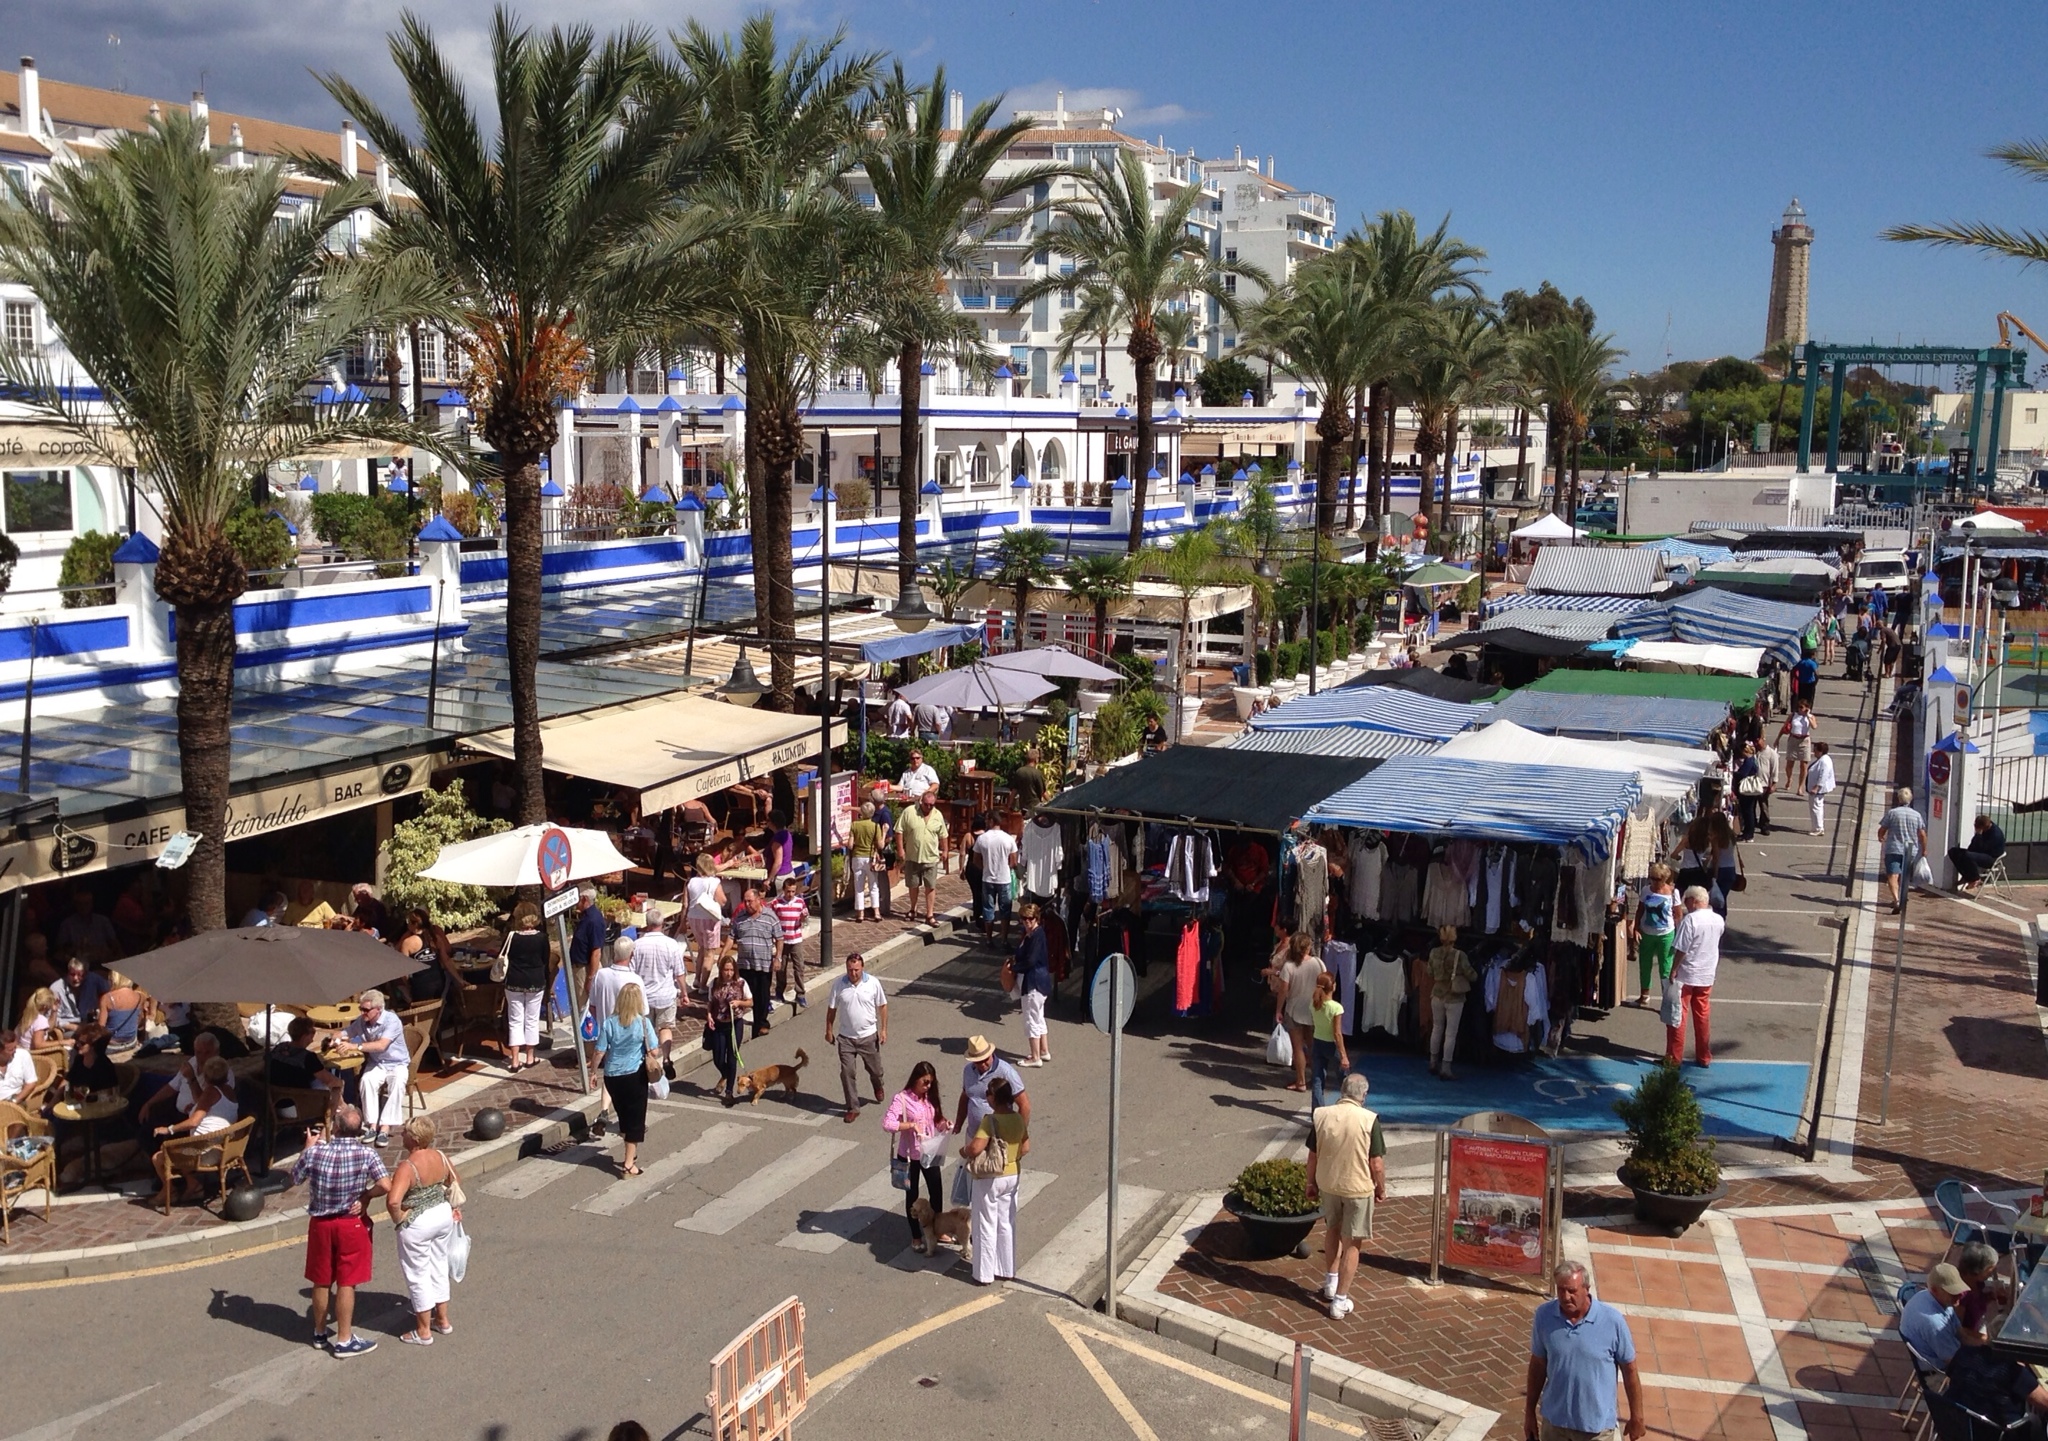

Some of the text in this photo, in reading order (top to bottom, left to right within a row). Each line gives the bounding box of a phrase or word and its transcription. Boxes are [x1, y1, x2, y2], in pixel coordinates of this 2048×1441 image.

[1878, 353, 1930, 361] PESCADORES
[1933, 353, 1975, 361] ESTEPONA
[39, 441, 93, 458] copas
[1115, 435, 1122, 450] EL
[695, 770, 731, 793] Cafeteria
[124, 782, 363, 851] CAFE Reinaldo BAR
[1469, 1145, 1500, 1153] AUTHENTIC
[1523, 1151, 1543, 1159] CUISINE
[1485, 1152, 1515, 1160] NAPOLITAN
